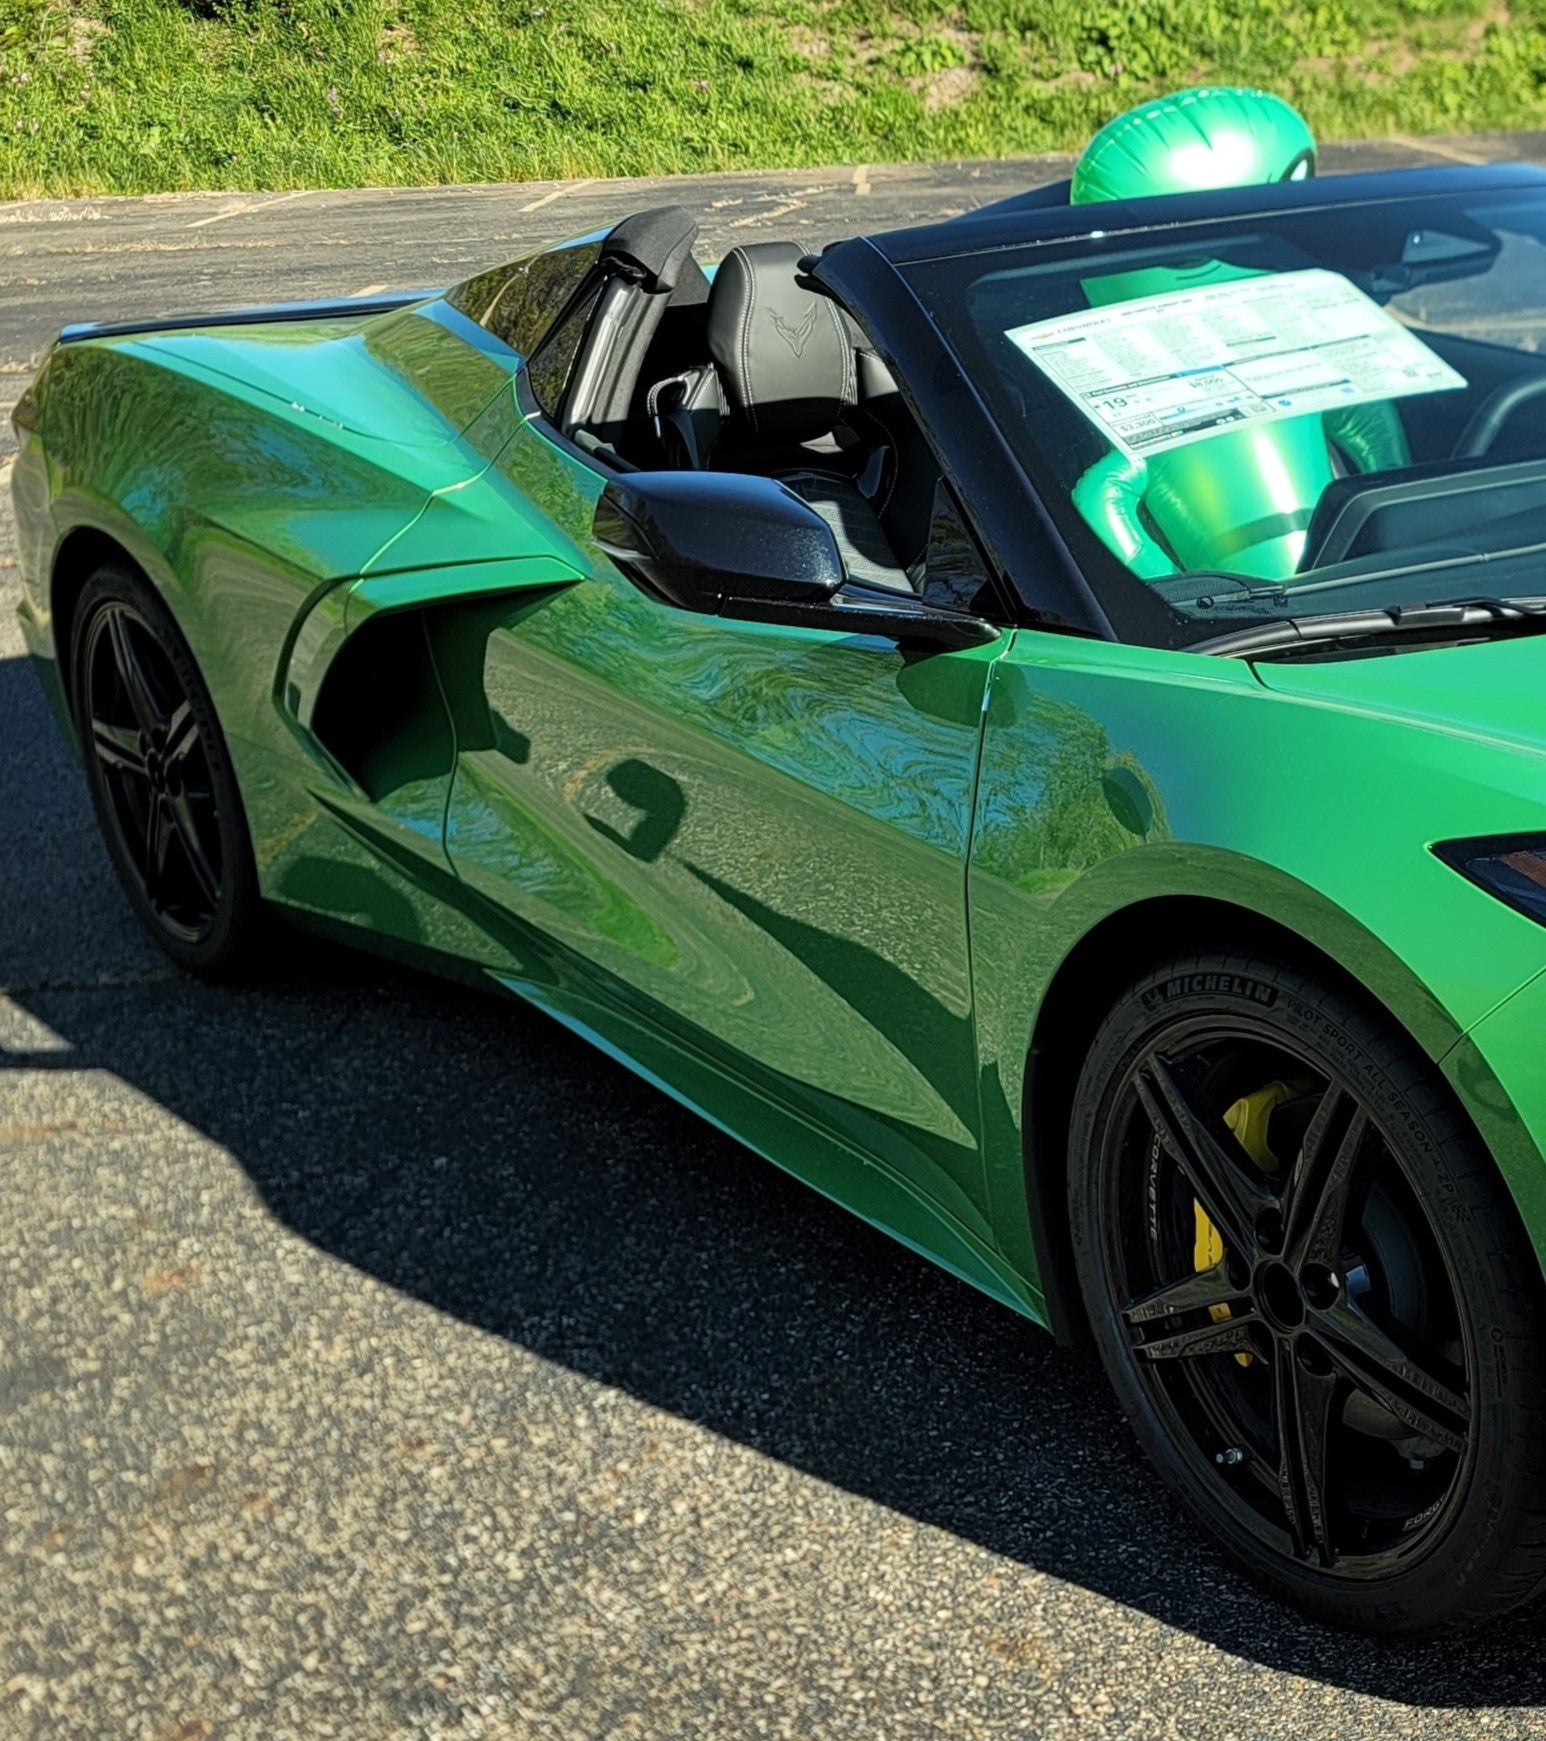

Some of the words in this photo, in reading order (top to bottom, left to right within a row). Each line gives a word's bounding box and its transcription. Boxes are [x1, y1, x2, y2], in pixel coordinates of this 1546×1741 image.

[1102, 396, 1128, 410] 19
[1166, 974, 1274, 1004] MICHELIN
[1286, 998, 1322, 1025] PILOT
[1321, 1023, 1365, 1062] SPORT
[1362, 1063, 1387, 1090] ALL
[1386, 1090, 1434, 1154] SEASON
[1437, 1172, 1456, 1194] ZP
[1147, 1132, 1162, 1242] CORVETTE
